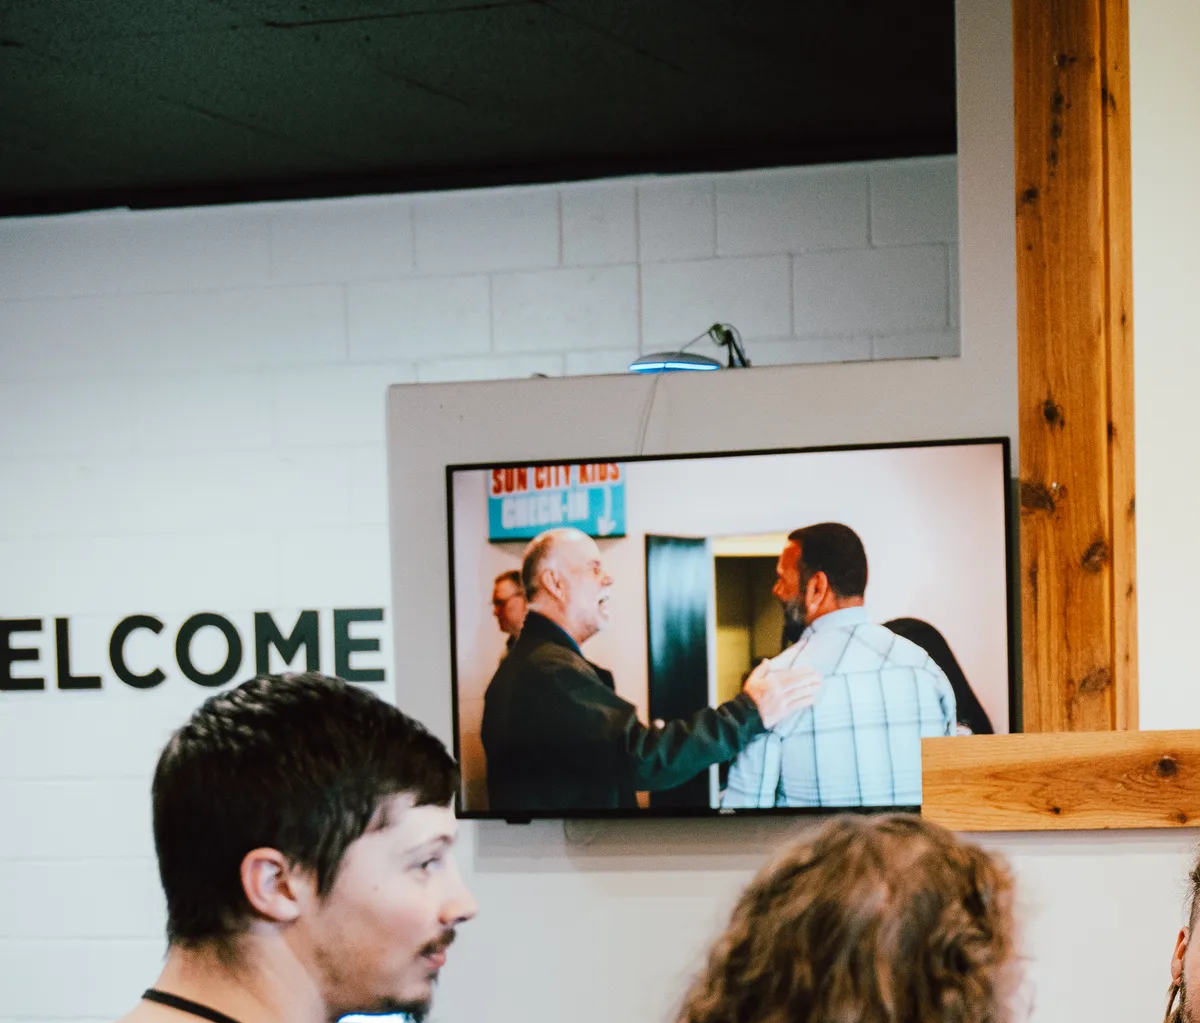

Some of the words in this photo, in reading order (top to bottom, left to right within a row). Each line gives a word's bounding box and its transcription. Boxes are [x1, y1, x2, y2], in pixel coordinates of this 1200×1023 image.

[492, 468, 528, 495] SUN
[534, 464, 571, 490] CITY
[0, 608, 385, 691] ELCOME
